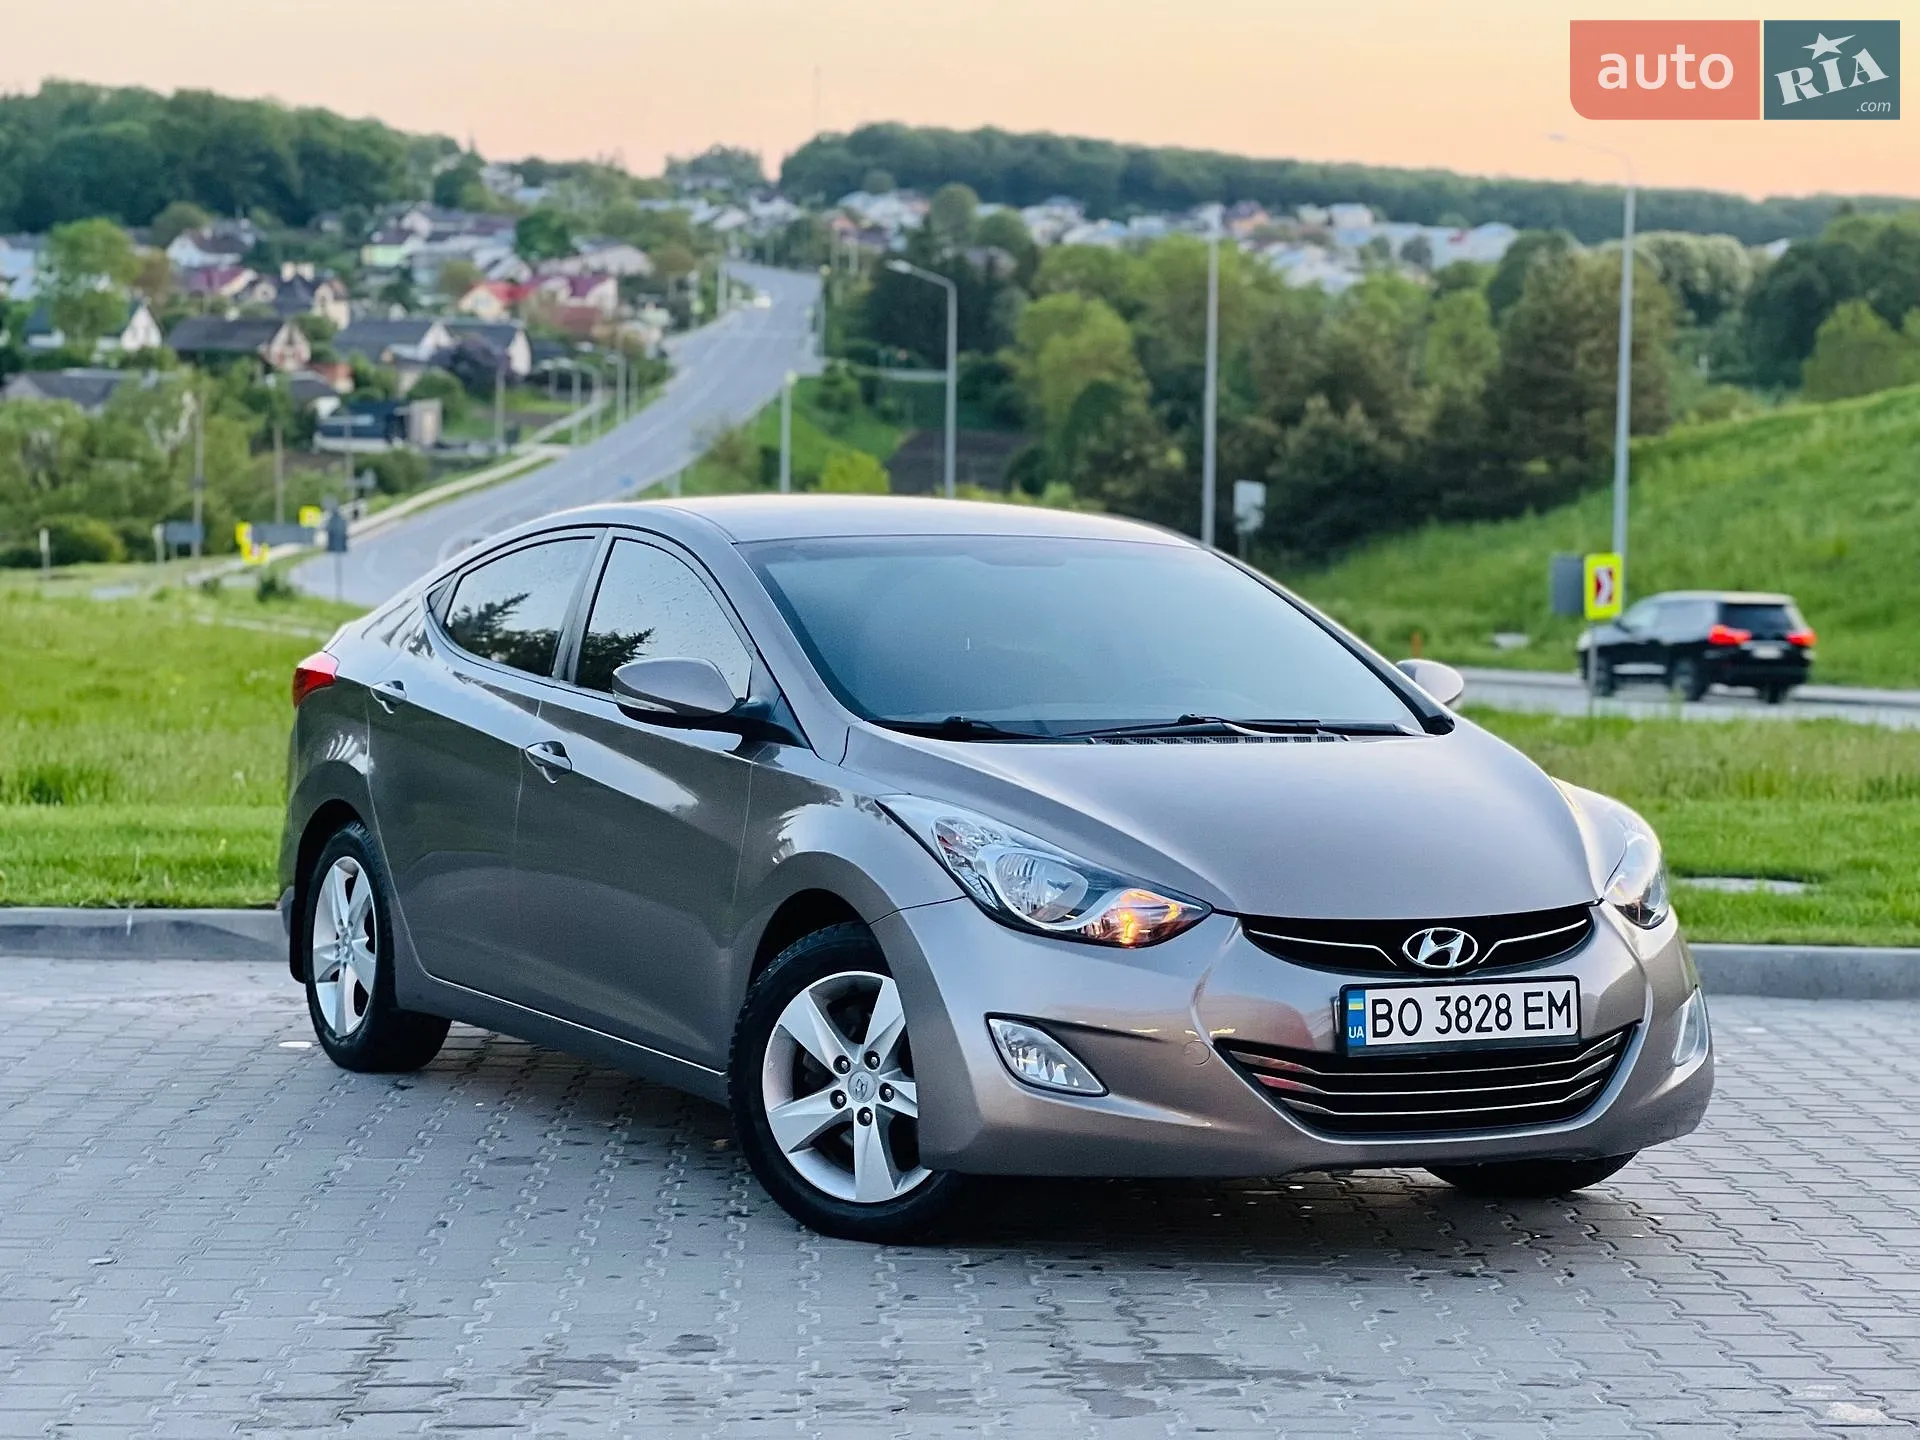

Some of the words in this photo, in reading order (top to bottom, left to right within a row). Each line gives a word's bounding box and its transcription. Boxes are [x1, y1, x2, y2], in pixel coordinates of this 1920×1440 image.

[1371, 997, 1423, 1038] BO
[1434, 993, 1513, 1034] 3828
[1523, 990, 1572, 1030] EM
[1348, 1026, 1365, 1038] UA
